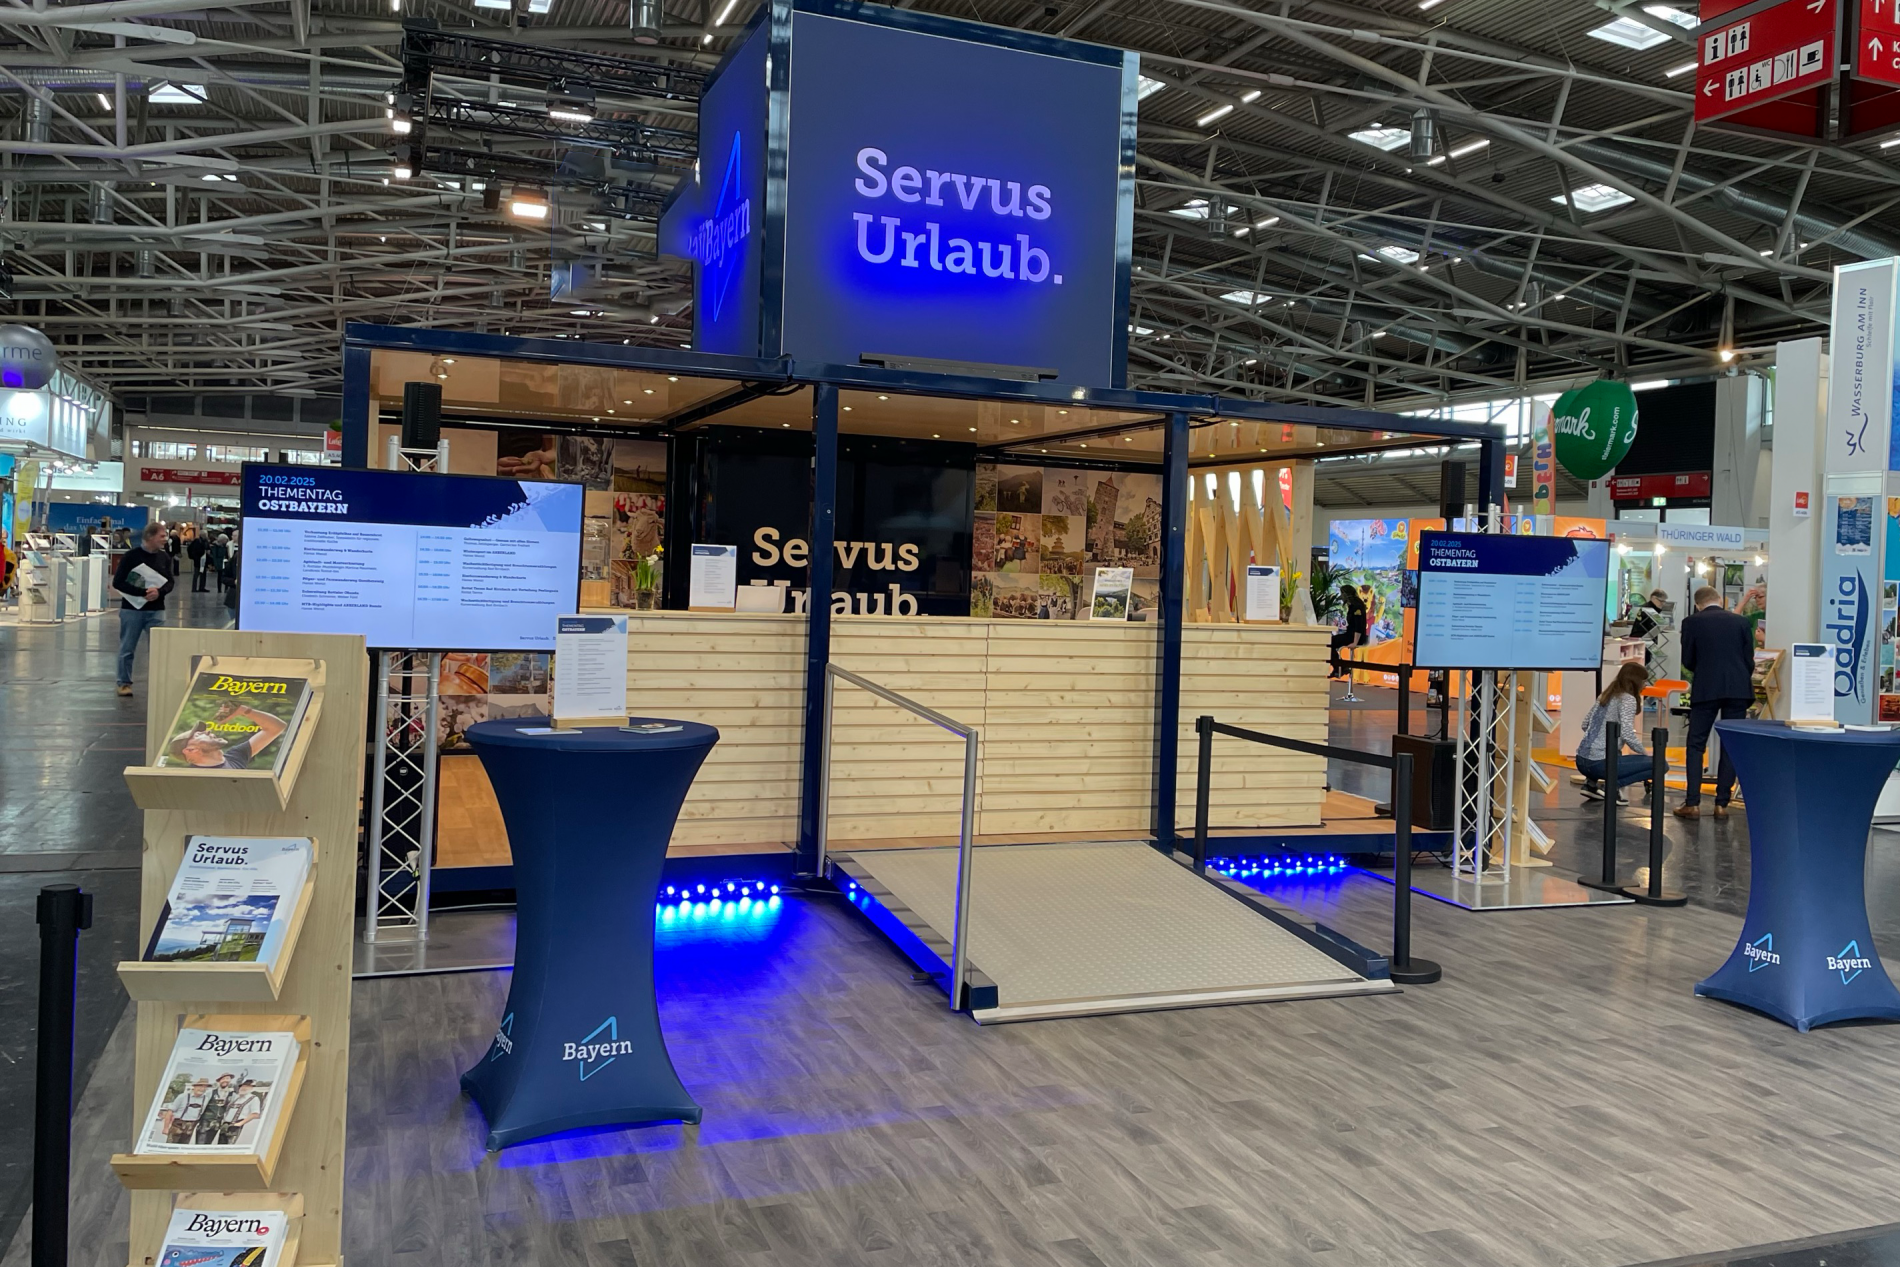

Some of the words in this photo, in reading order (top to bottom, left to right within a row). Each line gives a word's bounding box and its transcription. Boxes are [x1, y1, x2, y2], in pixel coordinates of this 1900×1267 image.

[1761, 60, 1771, 68] WC
[854, 147, 1052, 221] Servus
[704, 198, 751, 268] Bayern
[853, 212, 1064, 285] Urlaub.
[1857, 311, 1866, 333] AM
[259, 474, 316, 486] 20.02.2025
[258, 485, 343, 501] THEMENTAG
[258, 498, 349, 515] OSTBAYERN
[76, 516, 106, 525] Einfac
[1661, 529, 1714, 541] THÜRINGER
[1716, 533, 1742, 543] WALD
[752, 527, 920, 571] Sevus
[1430, 547, 1476, 558] THEMENTAG
[1429, 558, 1479, 568] OSTBAYERN
[209, 676, 287, 695] Bayern
[206, 721, 262, 733] Outdoor
[196, 843, 249, 855] Servus
[192, 853, 249, 866] Urlaub.
[1744, 943, 1780, 965] Bayern
[1826, 956, 1871, 972] Bayern
[196, 1034, 273, 1056] Bayern
[562, 1040, 633, 1063] Bayern
[184, 1213, 261, 1237] Bayern
